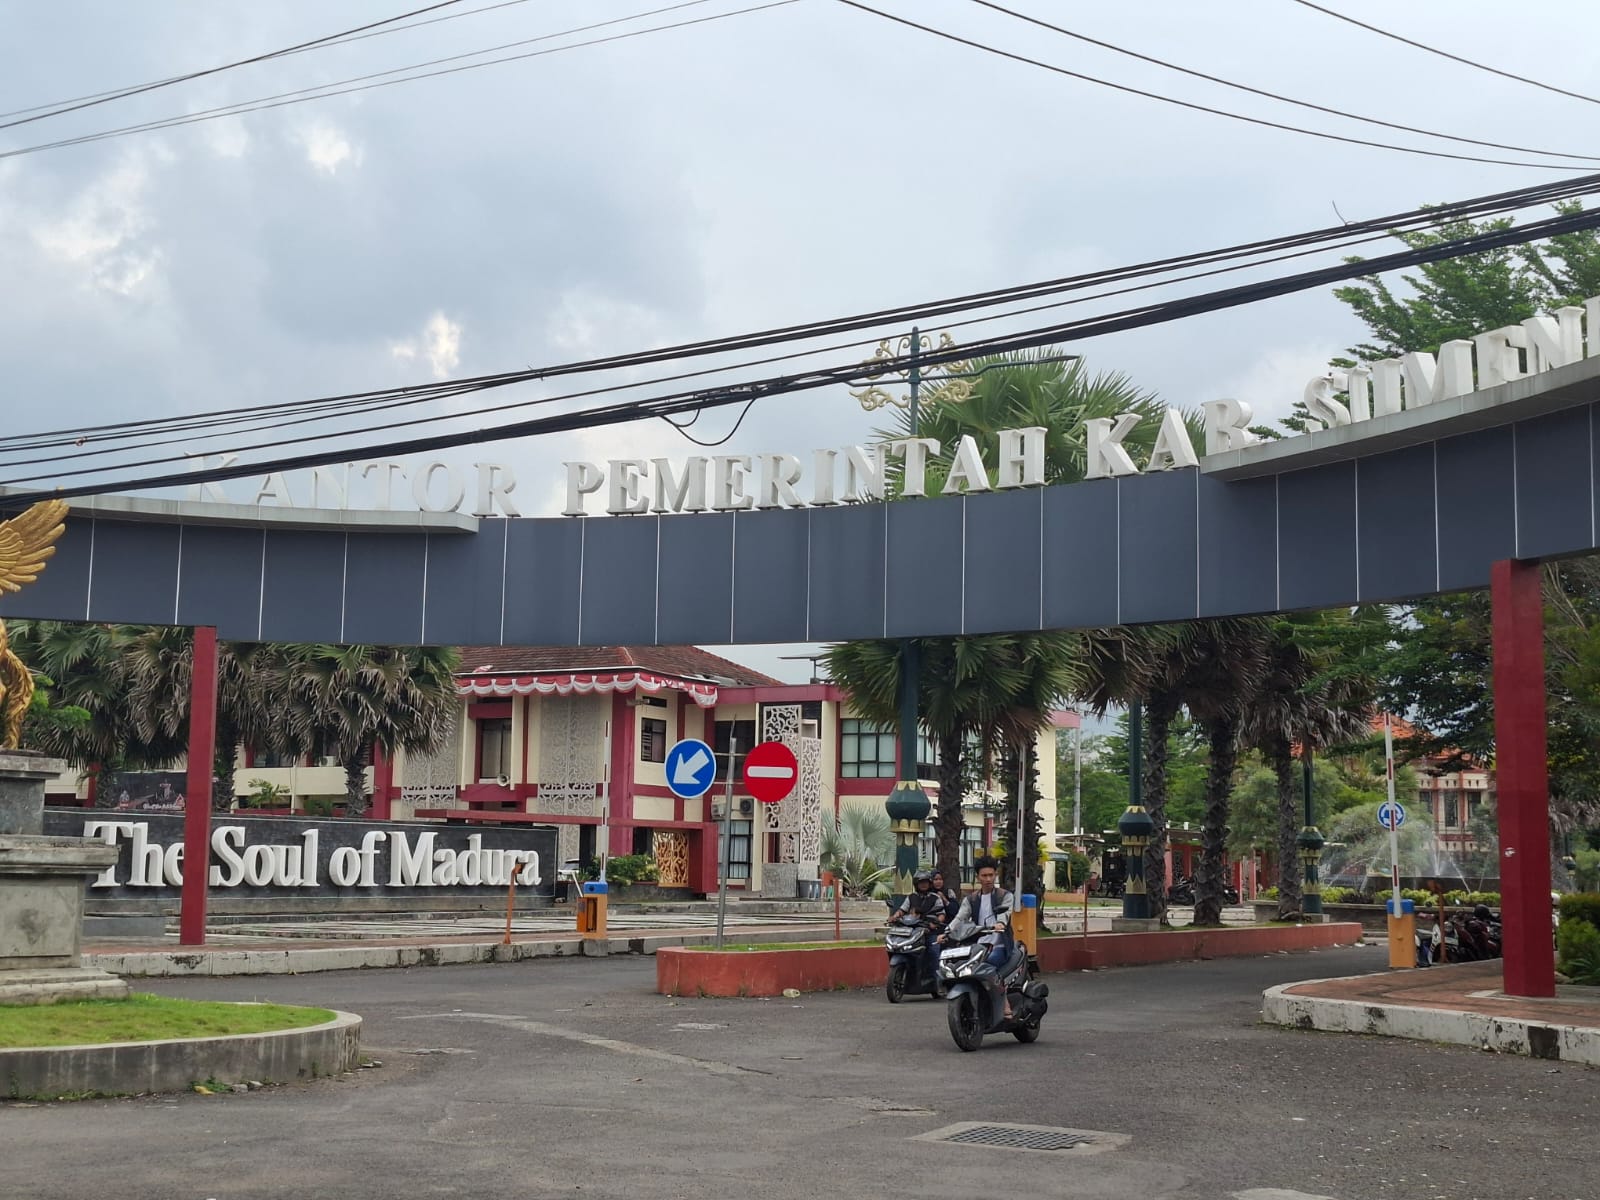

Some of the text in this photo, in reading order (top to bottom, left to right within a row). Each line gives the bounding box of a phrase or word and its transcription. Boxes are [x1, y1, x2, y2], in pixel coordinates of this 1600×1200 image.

[185, 451, 521, 518] KANTOR
[561, 427, 1050, 516] PEMERINTAH
[83, 821, 542, 888] The Soul of Madura
